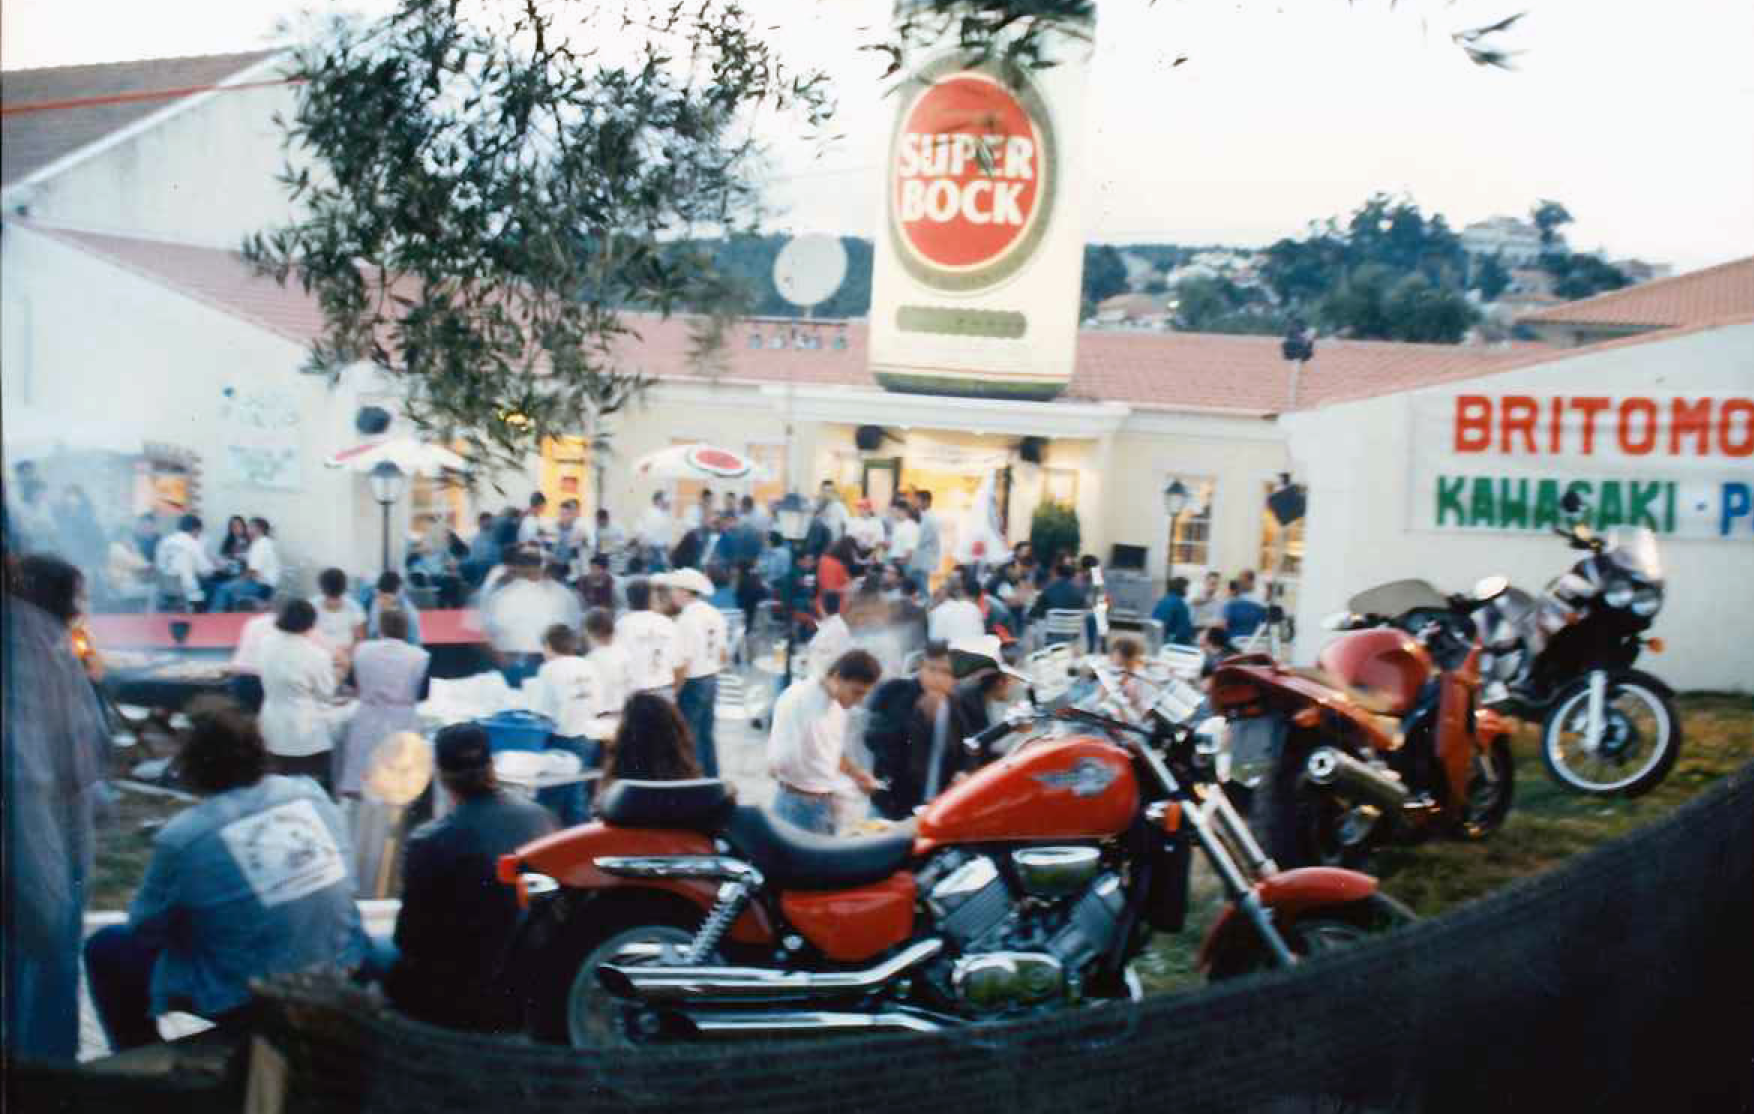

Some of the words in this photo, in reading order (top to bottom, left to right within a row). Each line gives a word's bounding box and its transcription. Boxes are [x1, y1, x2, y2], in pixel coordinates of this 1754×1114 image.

[900, 133, 1033, 179] SUPER
[902, 181, 1024, 225] BOCK
[1455, 395, 1754, 456] BRITOMO
